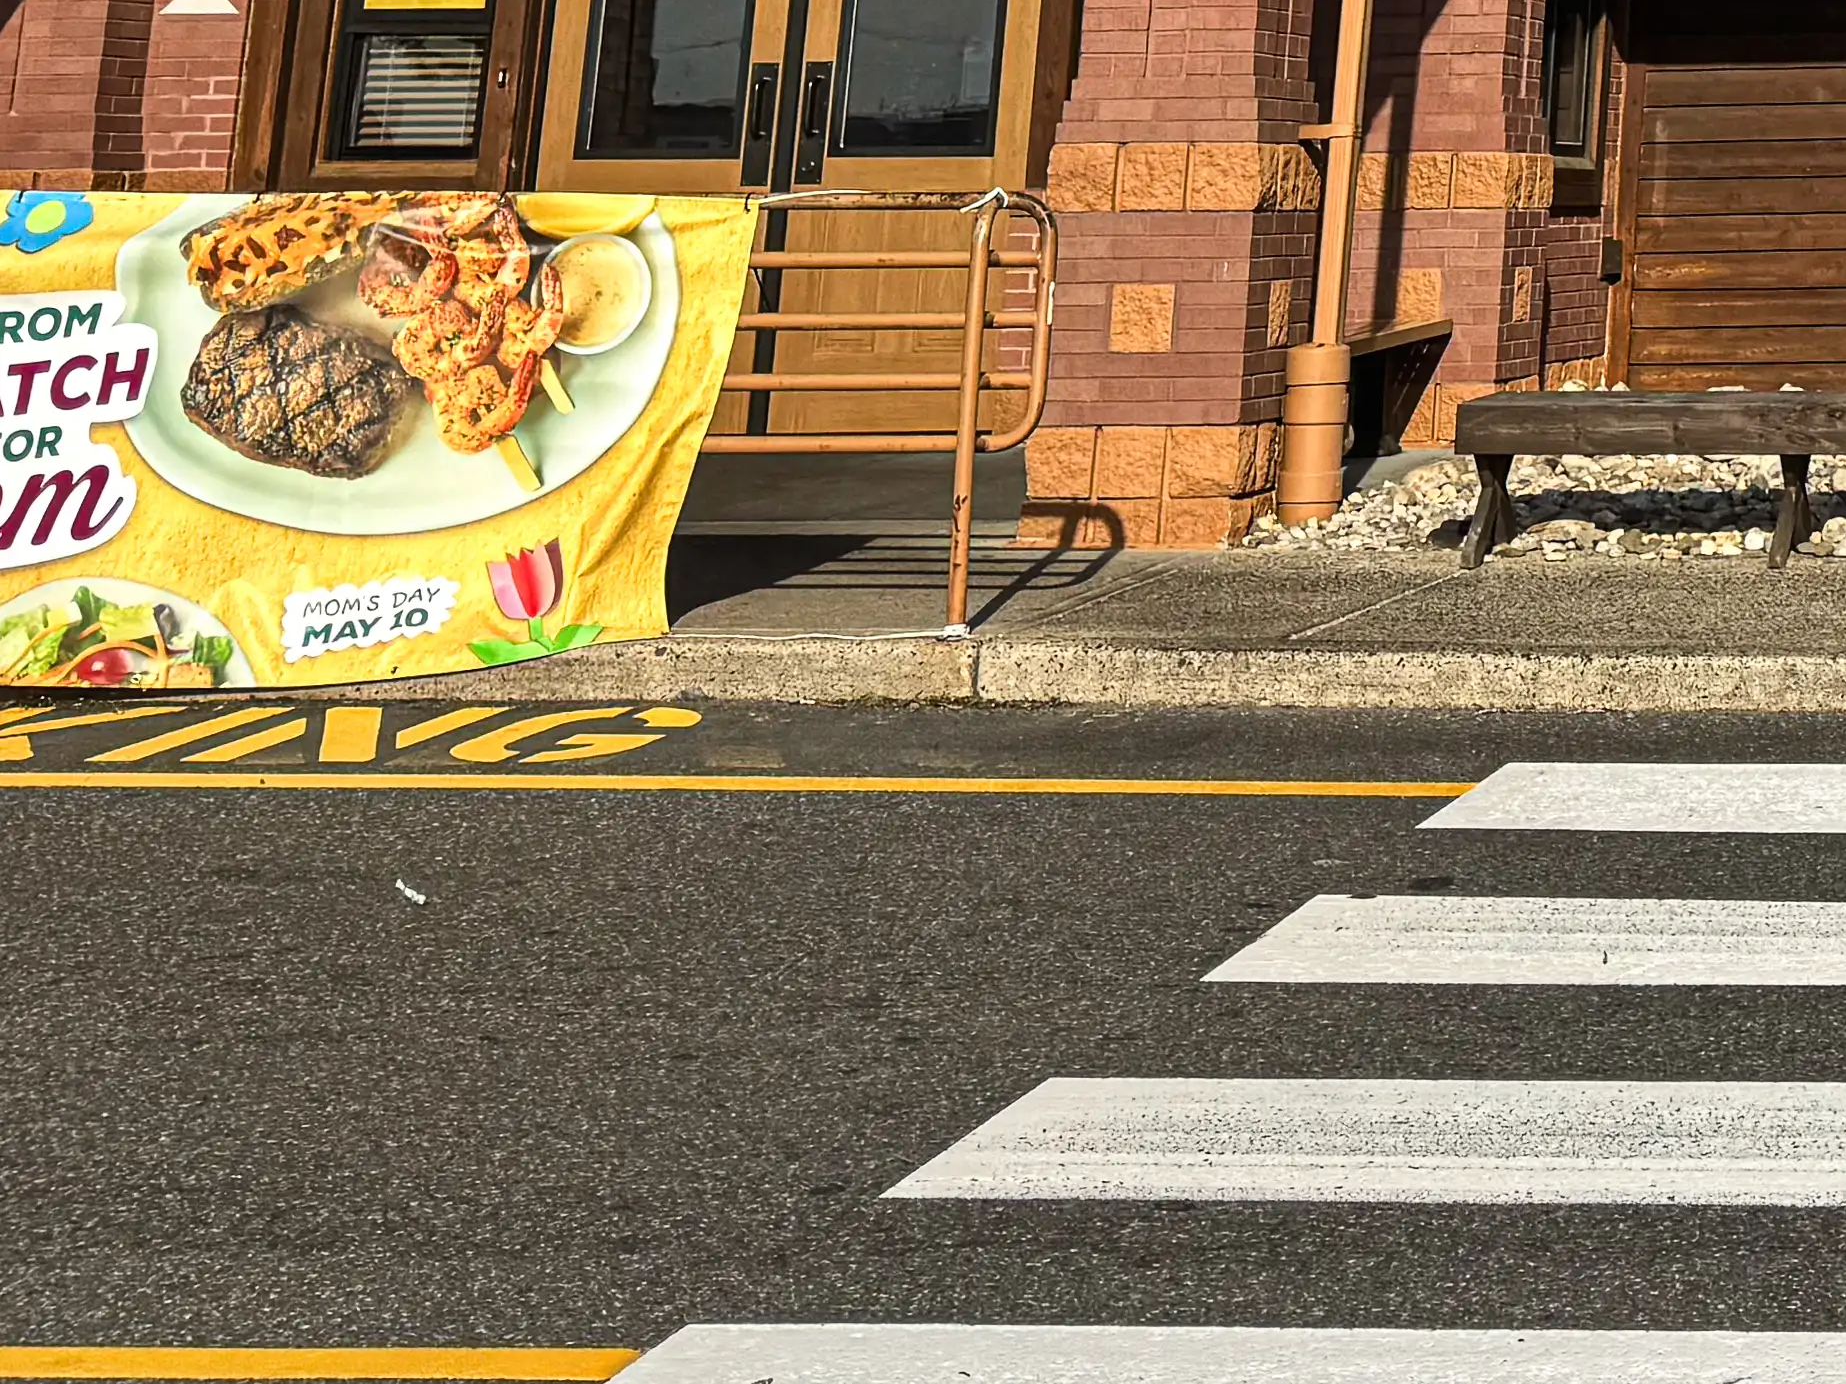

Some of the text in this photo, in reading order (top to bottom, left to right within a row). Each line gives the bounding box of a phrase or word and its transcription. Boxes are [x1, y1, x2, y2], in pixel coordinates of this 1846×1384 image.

[0, 348, 150, 417] TCH
[302, 588, 440, 618] MOM'S DAY
[302, 608, 428, 647] MAY 10
